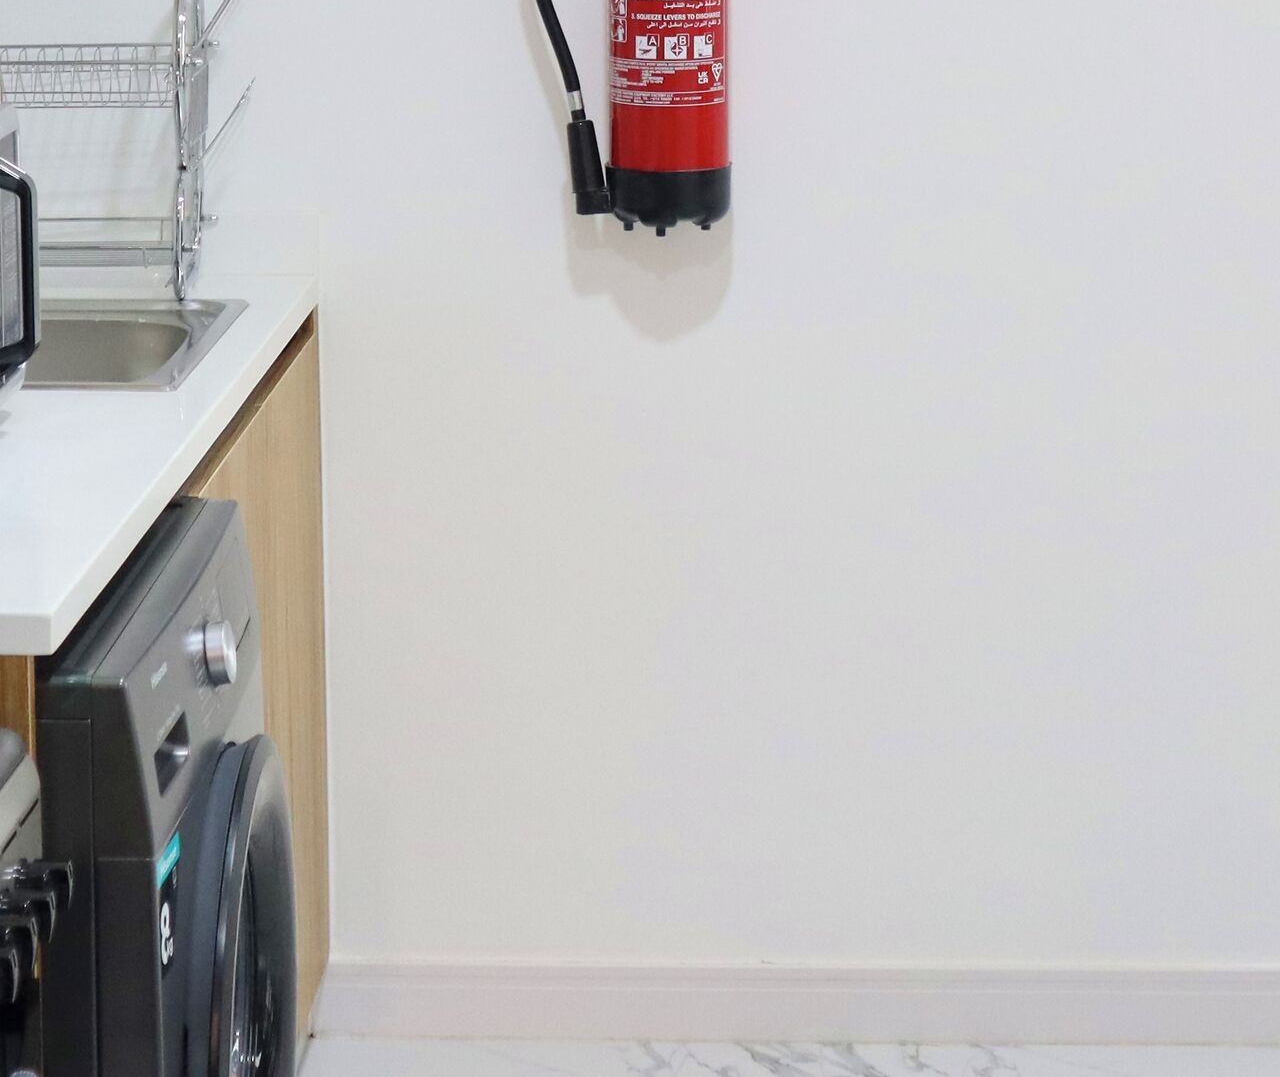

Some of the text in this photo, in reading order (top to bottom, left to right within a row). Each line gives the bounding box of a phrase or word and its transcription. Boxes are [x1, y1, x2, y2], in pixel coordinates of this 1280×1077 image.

[648, 35, 657, 45] A
[679, 35, 687, 45] B
[705, 34, 713, 44] C
